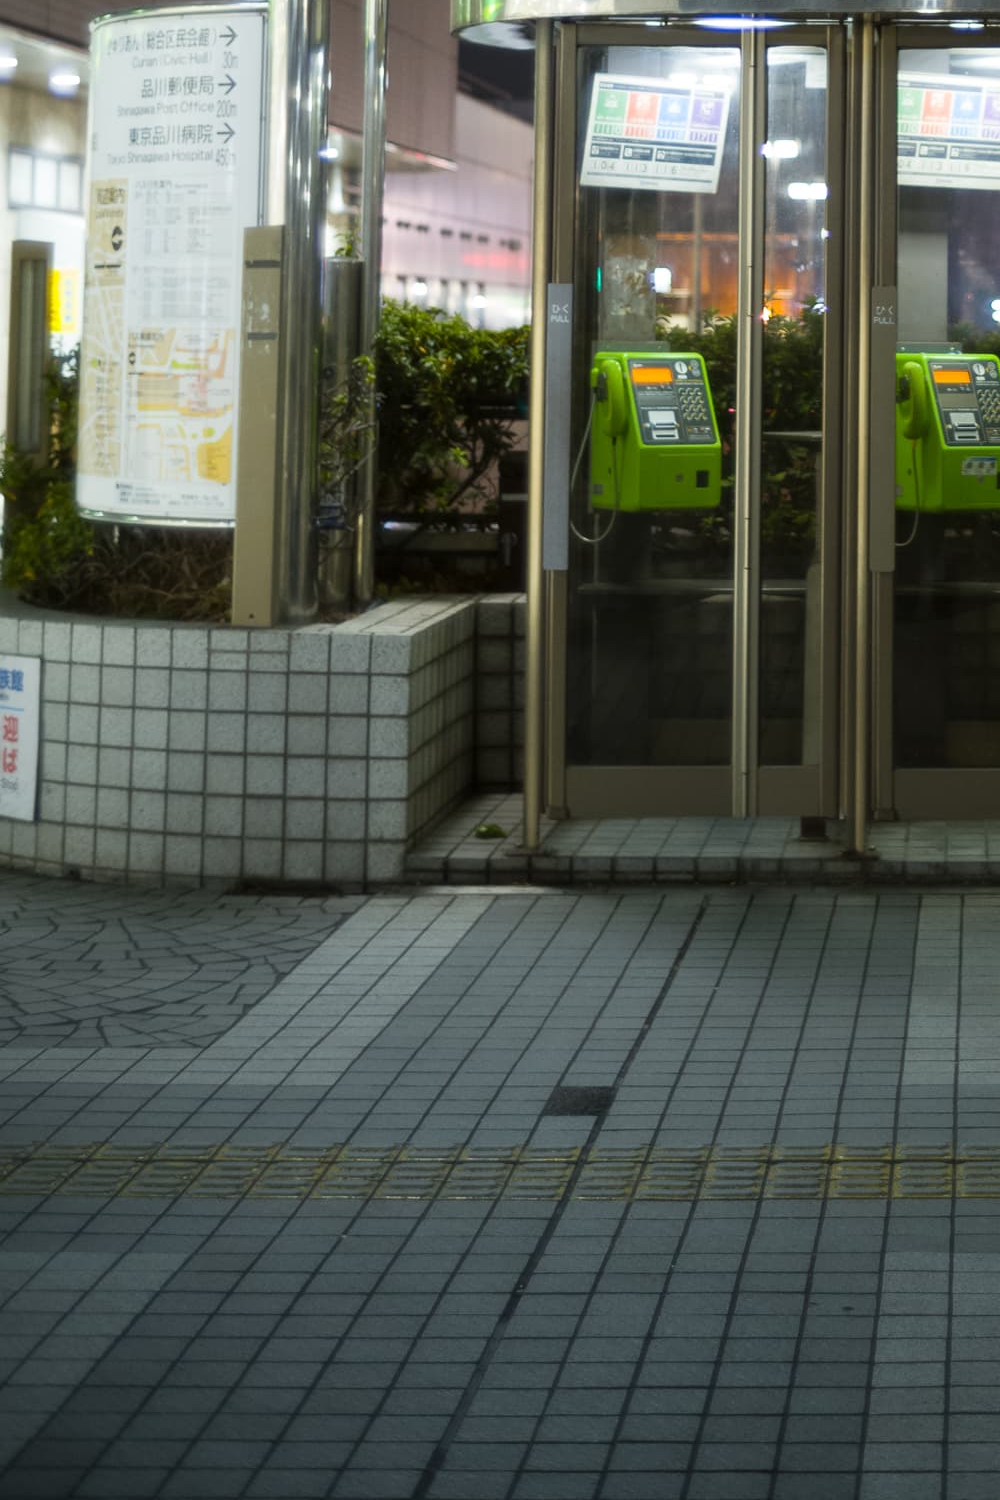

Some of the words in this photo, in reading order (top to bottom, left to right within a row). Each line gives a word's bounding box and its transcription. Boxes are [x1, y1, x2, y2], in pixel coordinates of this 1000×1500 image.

[141, 75, 214, 98] 品川郵便局
[117, 104, 156, 117] Shinagawa
[157, 102, 178, 115] Post
[179, 101, 214, 114] Office
[128, 124, 214, 146] 東京品川病院
[127, 151, 170, 165] Shinagawa
[172, 148, 214, 163] Hospital
[550, 315, 569, 323] PULL
[873, 316, 896, 324] PULL
